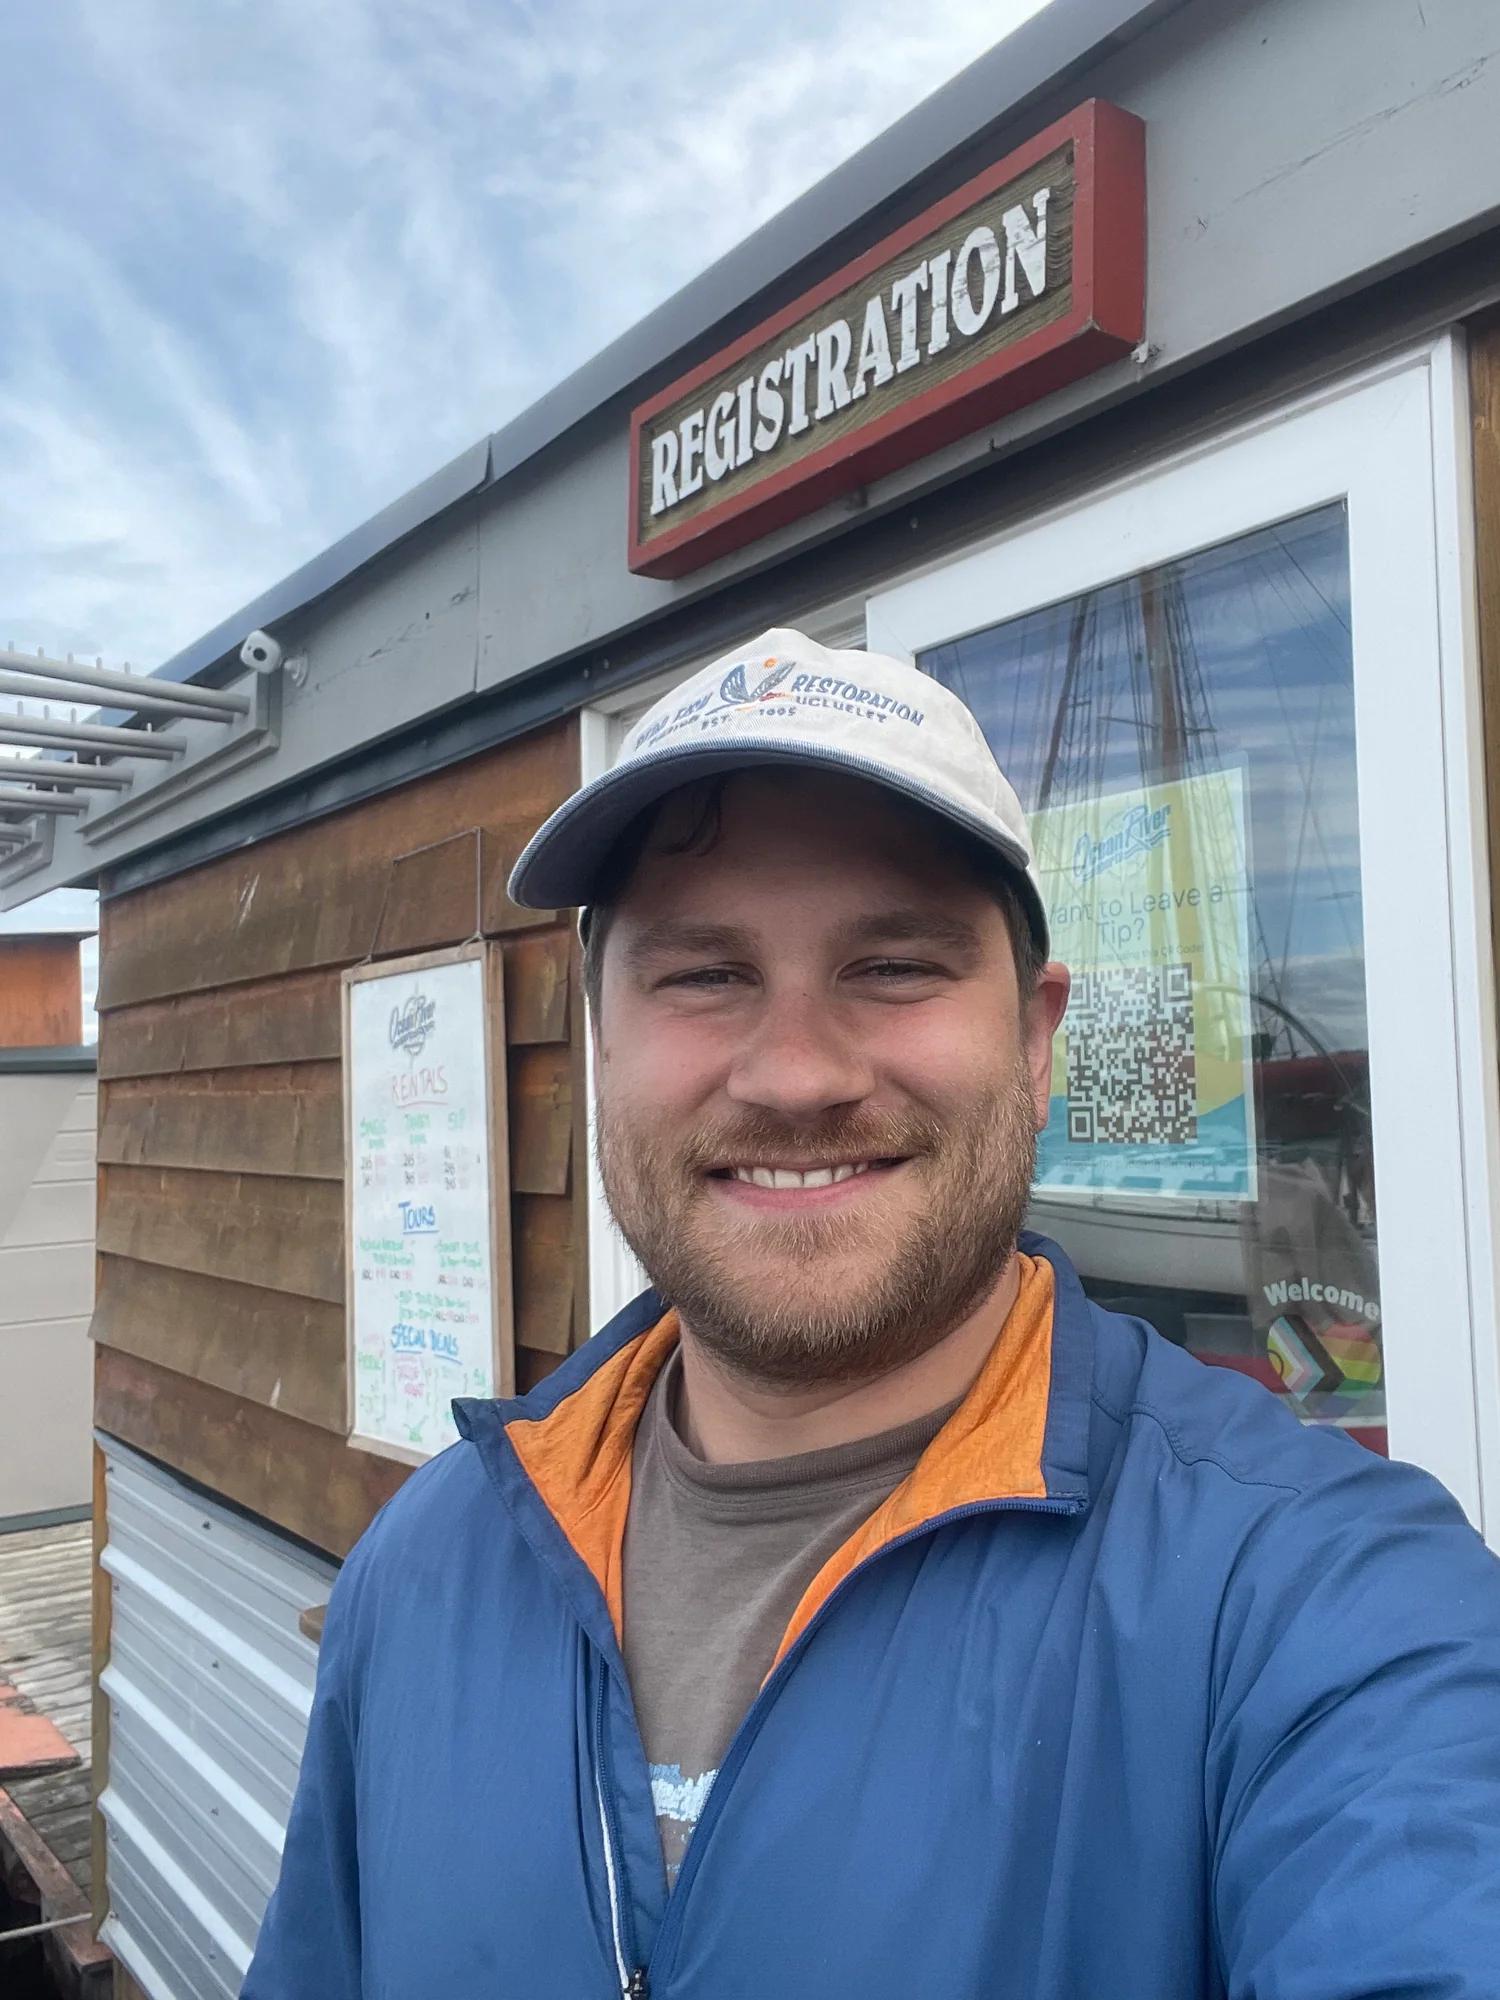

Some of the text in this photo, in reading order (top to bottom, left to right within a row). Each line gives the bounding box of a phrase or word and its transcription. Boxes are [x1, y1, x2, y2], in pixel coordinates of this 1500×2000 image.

[650, 187, 1050, 516] REGISTRATION
[791, 673, 925, 726] RESTORATION
[796, 695, 888, 723] UCLUELET
[1099, 898, 1123, 918] to
[1130, 887, 1202, 915] Leave
[1210, 884, 1223, 904] a
[1096, 917, 1145, 949] Tip?
[391, 1065, 448, 1102] RENTALS
[1263, 1277, 1380, 1321] Welcome
